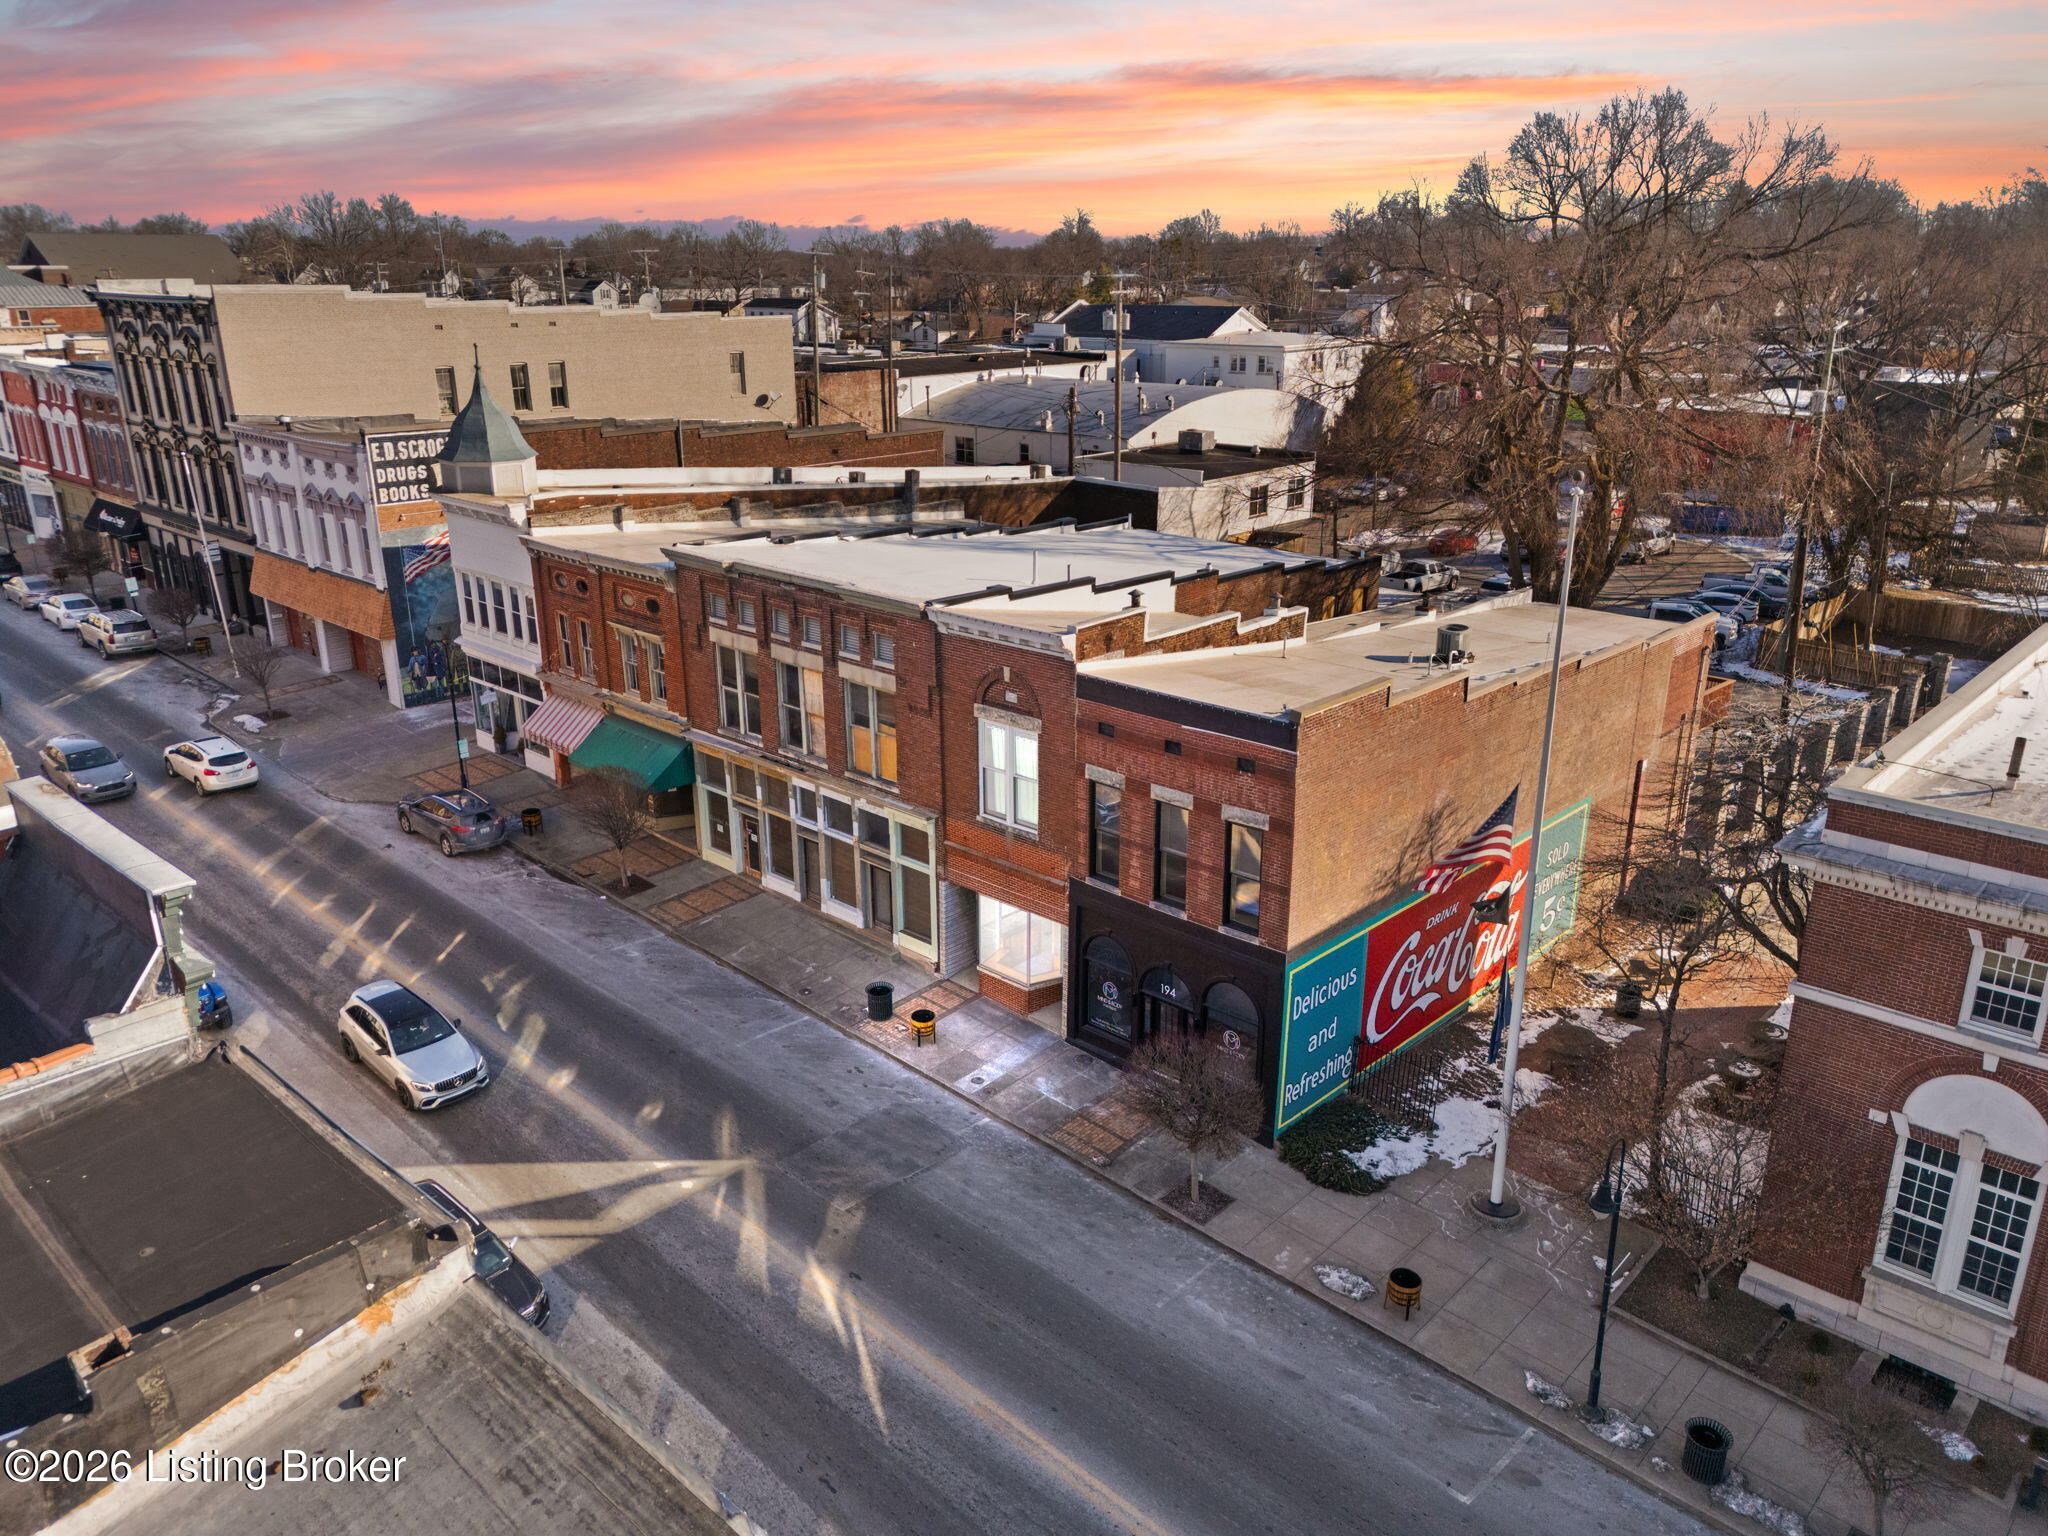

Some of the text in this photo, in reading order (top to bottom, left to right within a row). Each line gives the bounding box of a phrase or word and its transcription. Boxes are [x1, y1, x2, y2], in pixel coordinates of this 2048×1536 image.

[375, 464, 428, 484] DRUGS
[379, 483, 430, 503] BOOKS
[1546, 841, 1570, 868] SOLD
[1426, 901, 1460, 931] DRINK
[1160, 983, 1176, 998] 194
[1292, 967, 1357, 1021] Delicious
[1308, 1016, 1338, 1053] and
[1284, 1045, 1353, 1107] Refreshing
